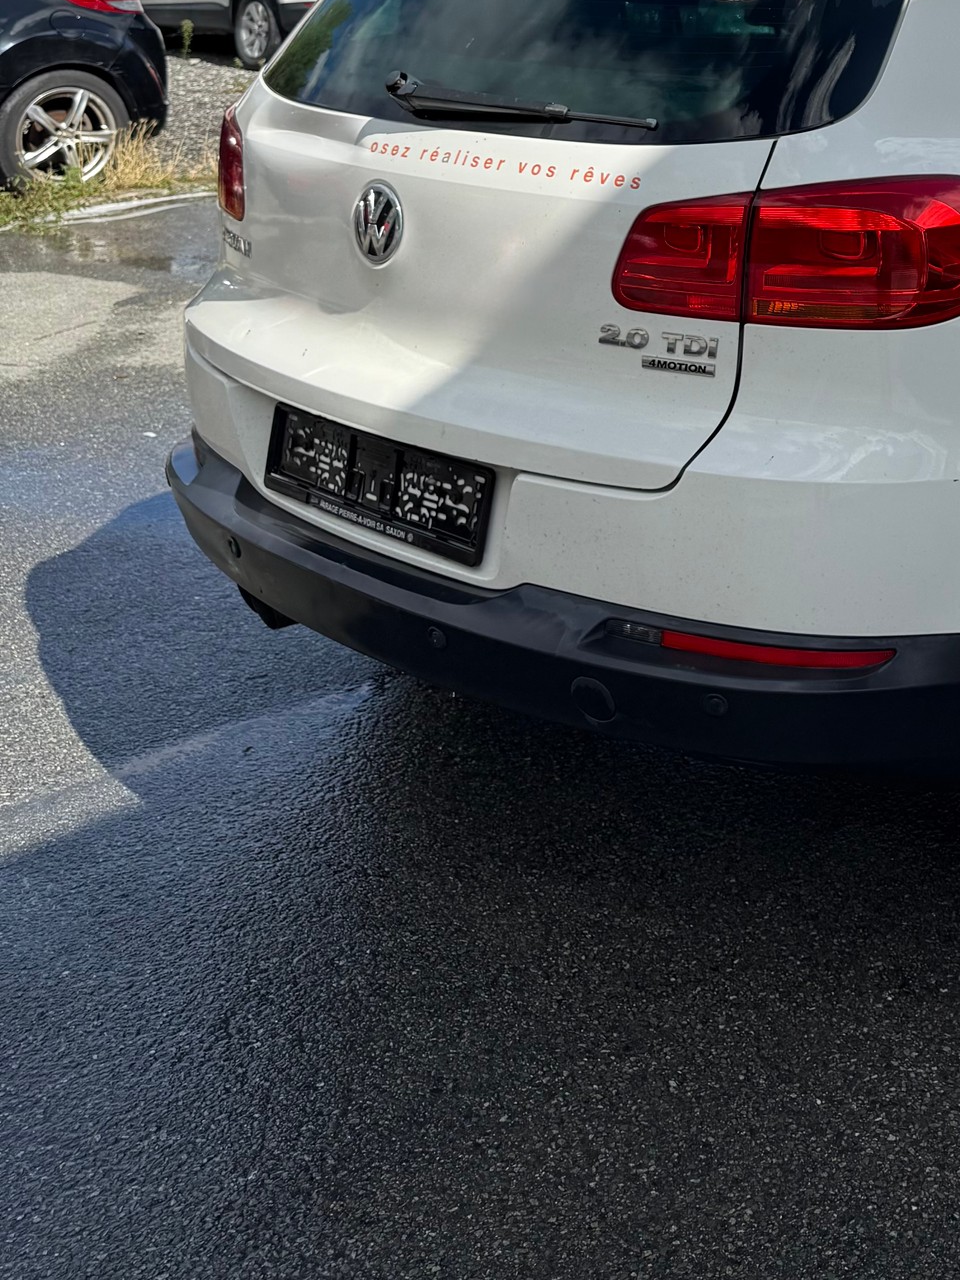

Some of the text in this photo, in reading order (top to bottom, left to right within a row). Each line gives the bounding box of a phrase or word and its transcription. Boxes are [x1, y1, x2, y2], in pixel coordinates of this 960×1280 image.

[370, 141, 642, 190] osez réaliser vos rêves
[598, 323, 719, 359] 2.0 TDI
[648, 359, 708, 374] 4MOTION
[385, 525, 406, 539] SAXON
